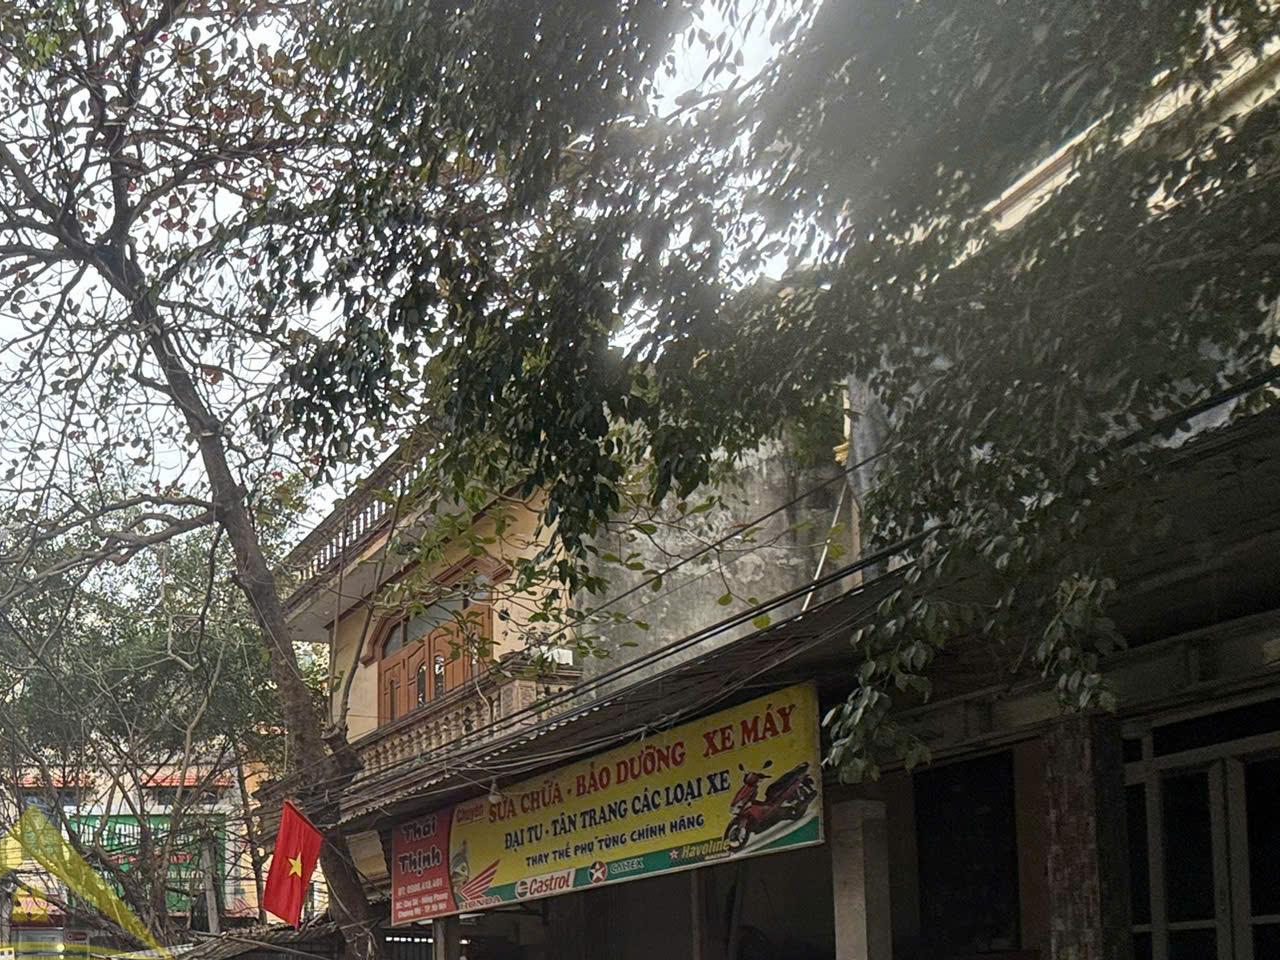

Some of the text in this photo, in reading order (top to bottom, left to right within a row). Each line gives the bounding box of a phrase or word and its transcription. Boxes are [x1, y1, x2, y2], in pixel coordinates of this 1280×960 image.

[520, 779, 564, 814] CHỮA
[575, 763, 611, 797] BẢO
[616, 741, 686, 785] DƯỠNG
[702, 725, 734, 758] XE
[740, 704, 796, 747] MÁY
[504, 830, 525, 852] ĐẠI
[526, 824, 543, 844] TU
[580, 800, 628, 829] TRANG
[630, 788, 661, 816] CÁC
[665, 777, 702, 808] LOẠI
[707, 770, 731, 795] XE
[402, 815, 438, 843] Thái
[526, 813, 704, 868] THAY THẾ PHỤ TÙNG CHÍNH HÃNG
[400, 845, 443, 877] Thịnh
[680, 838, 731, 859] Havoline
[609, 858, 644, 874] CALTEX
[528, 873, 572, 895] Castrol
[461, 895, 502, 911] HONDA
